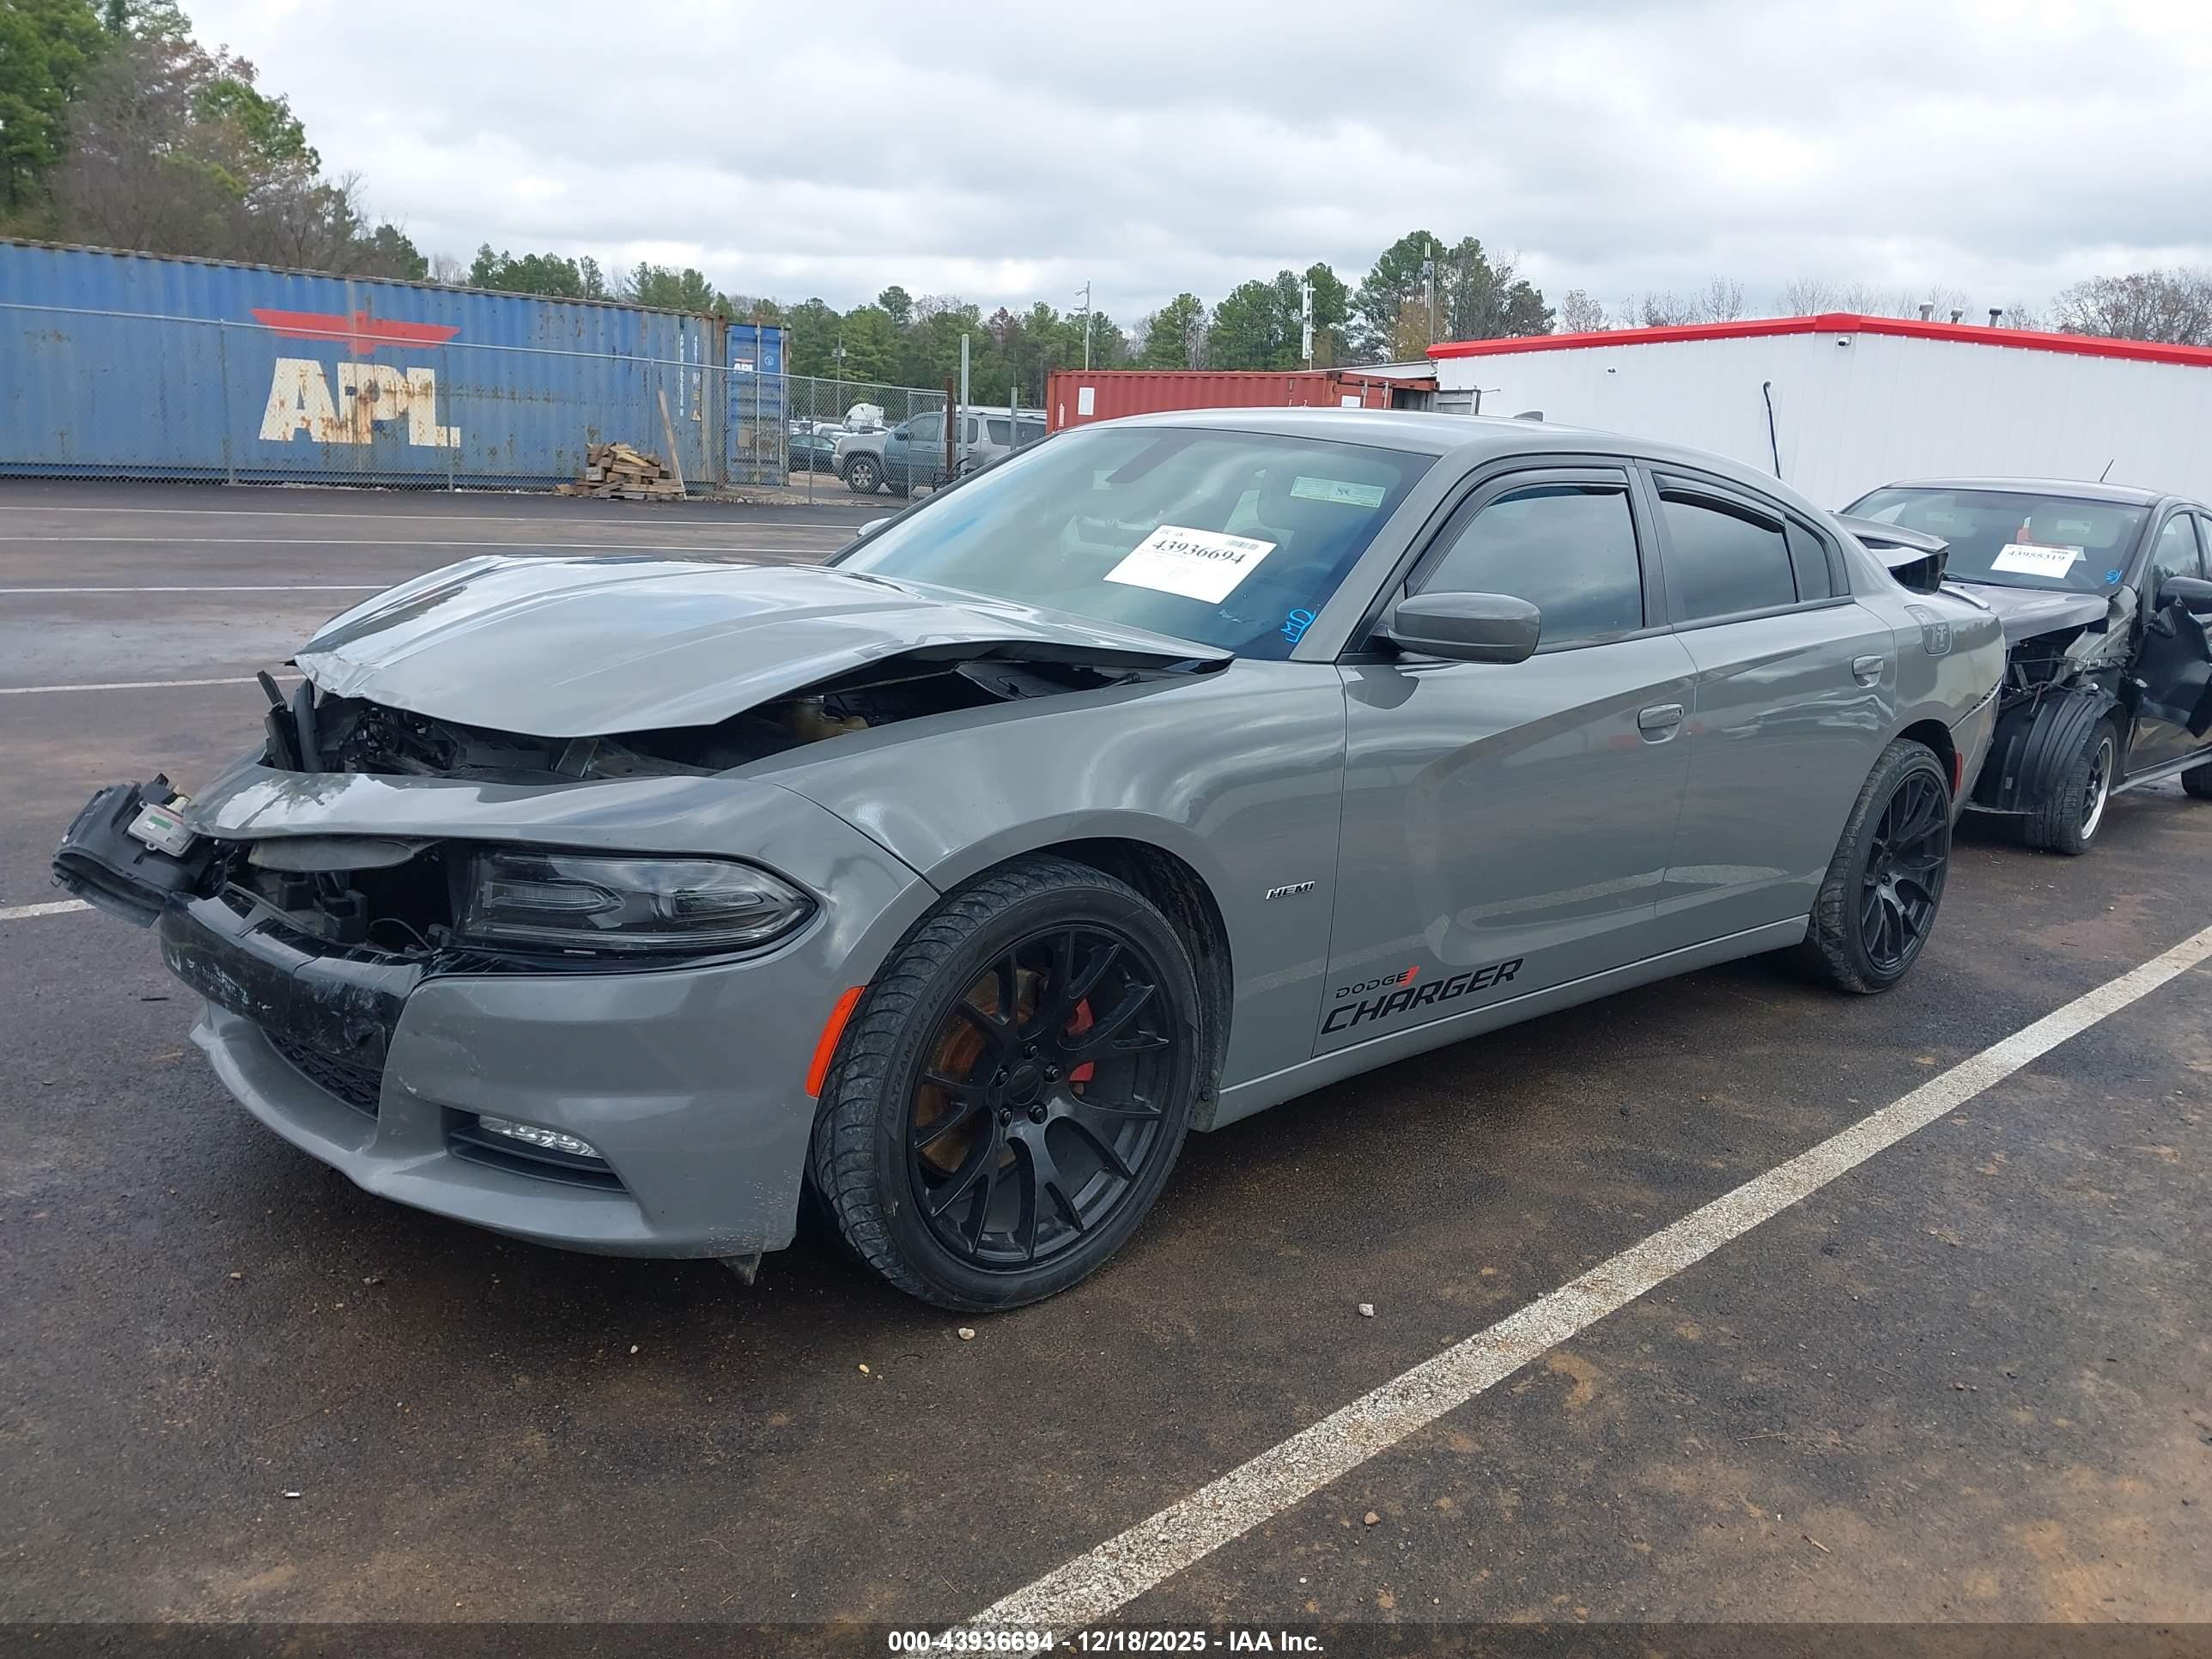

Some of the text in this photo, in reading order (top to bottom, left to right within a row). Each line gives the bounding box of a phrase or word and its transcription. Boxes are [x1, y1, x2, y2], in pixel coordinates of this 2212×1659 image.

[259, 357, 460, 447] APL
[1152, 539, 1247, 564] 43936694
[1266, 880, 1316, 900] HEMI
[1321, 957, 1524, 1035] CHARGER
[1336, 970, 1409, 999] DODGE
